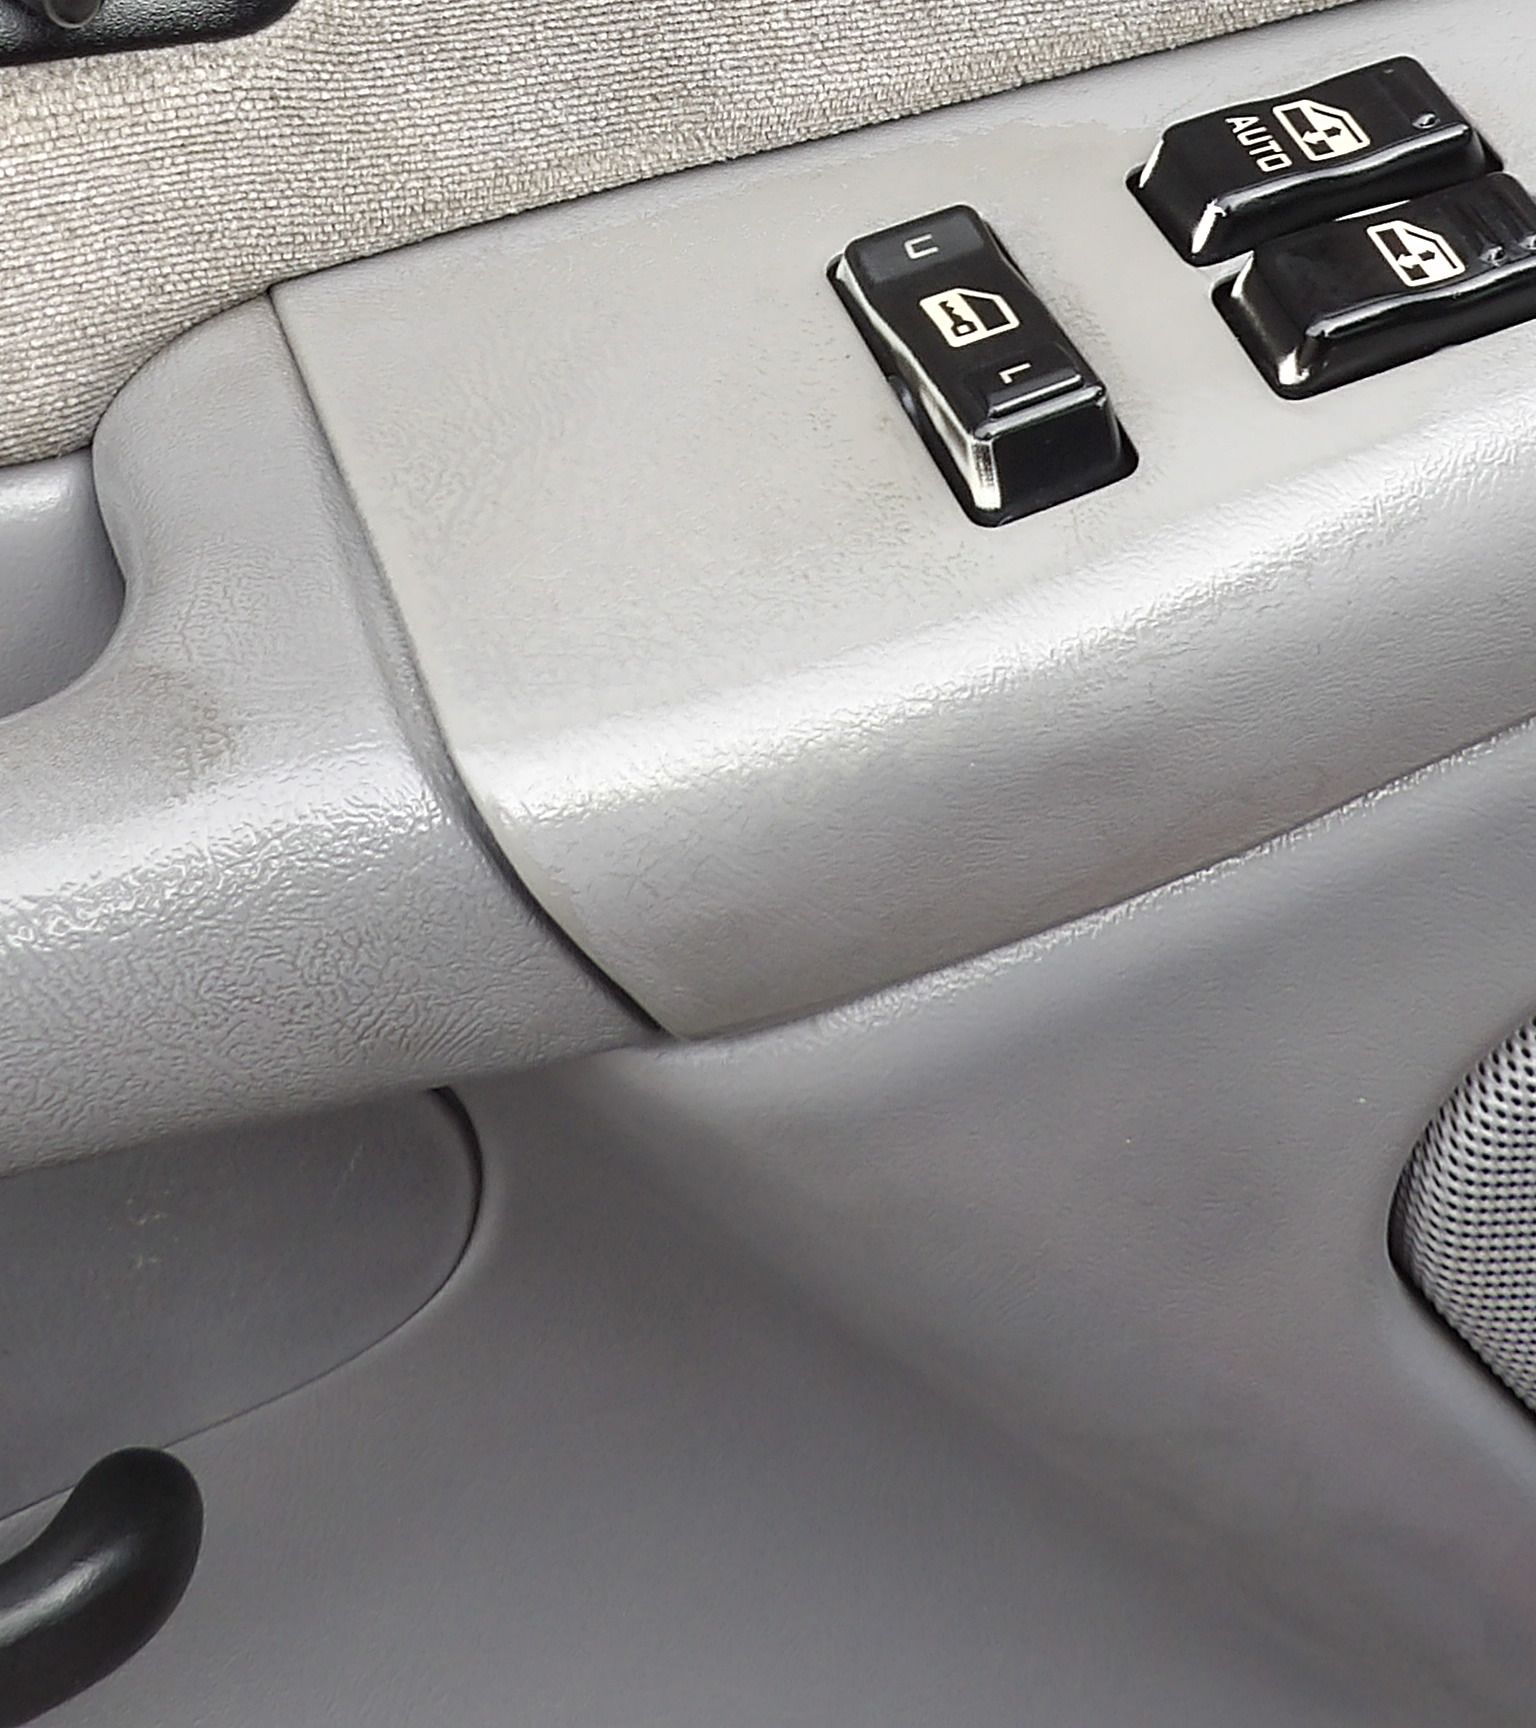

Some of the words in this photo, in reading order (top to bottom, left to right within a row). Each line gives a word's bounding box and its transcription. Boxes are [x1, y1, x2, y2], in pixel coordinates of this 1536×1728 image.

[1225, 116, 1293, 173] AUTO
[904, 233, 939, 259] U
[998, 362, 1032, 384] L
